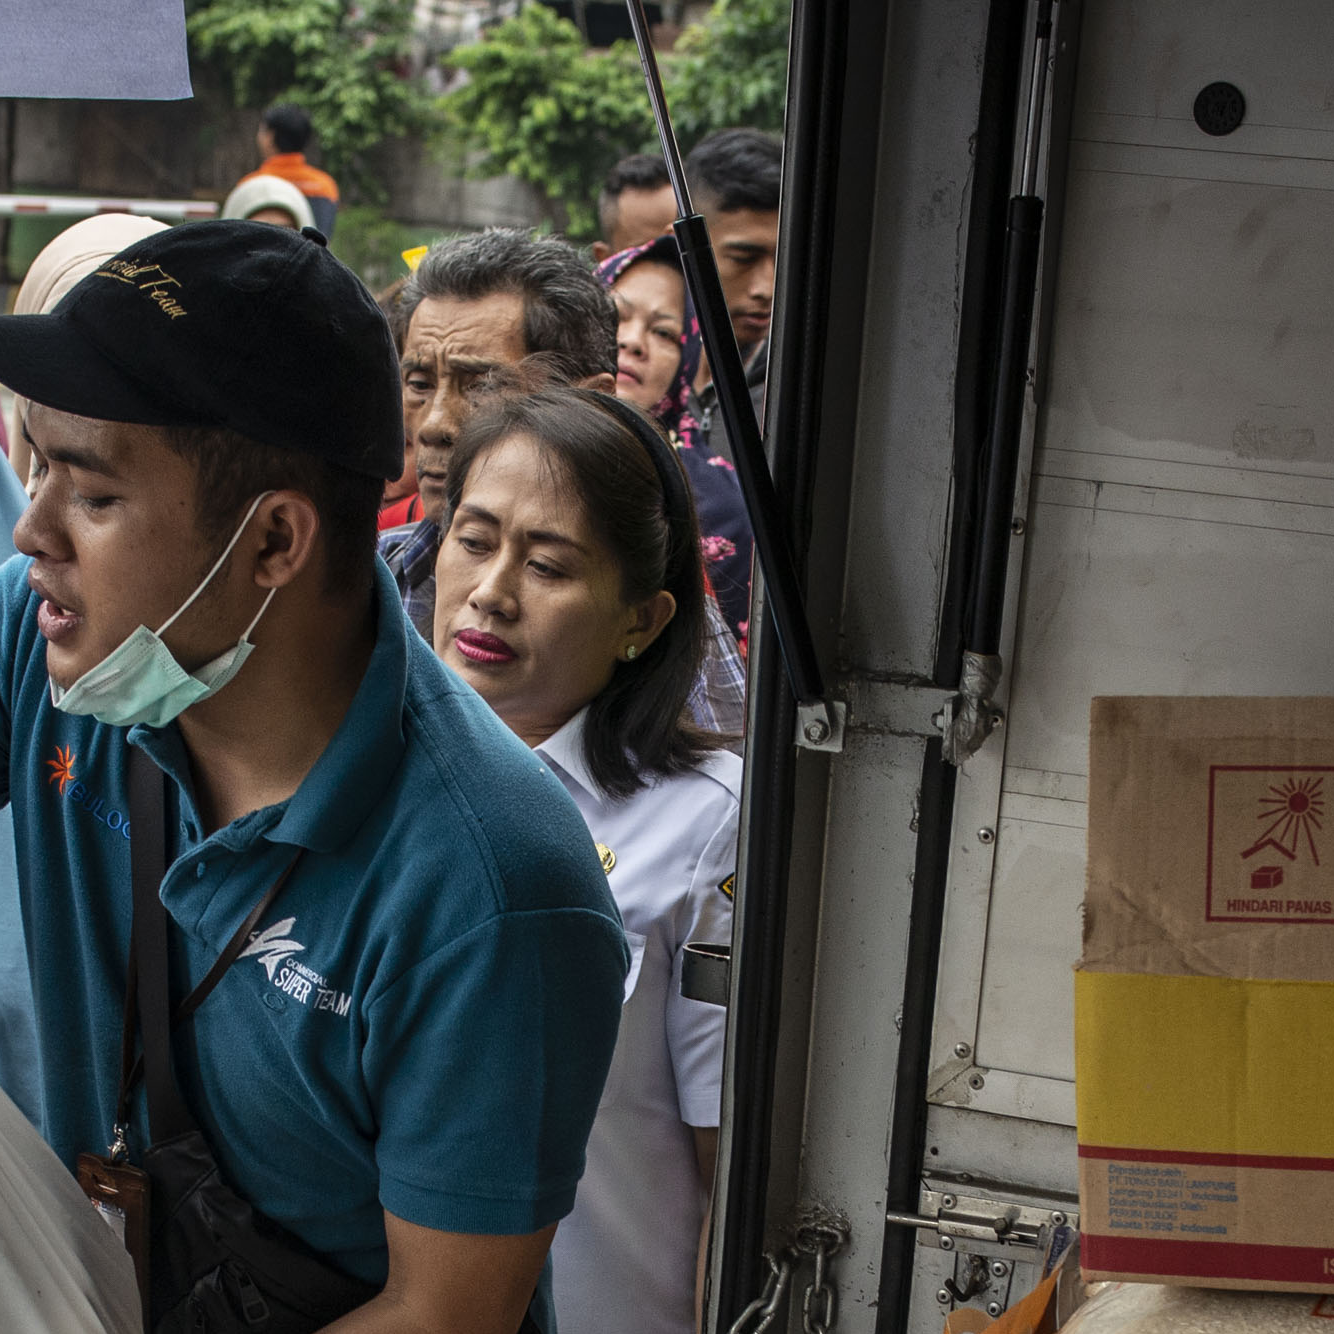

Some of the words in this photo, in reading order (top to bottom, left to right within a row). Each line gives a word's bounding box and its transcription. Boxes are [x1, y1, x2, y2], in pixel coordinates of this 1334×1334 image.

[139, 271, 188, 320] Team
[1227, 899, 1283, 913] HINDARI
[1286, 900, 1332, 914] PANAS
[274, 967, 312, 1005] SUPER
[313, 988, 353, 1017] TEAM
